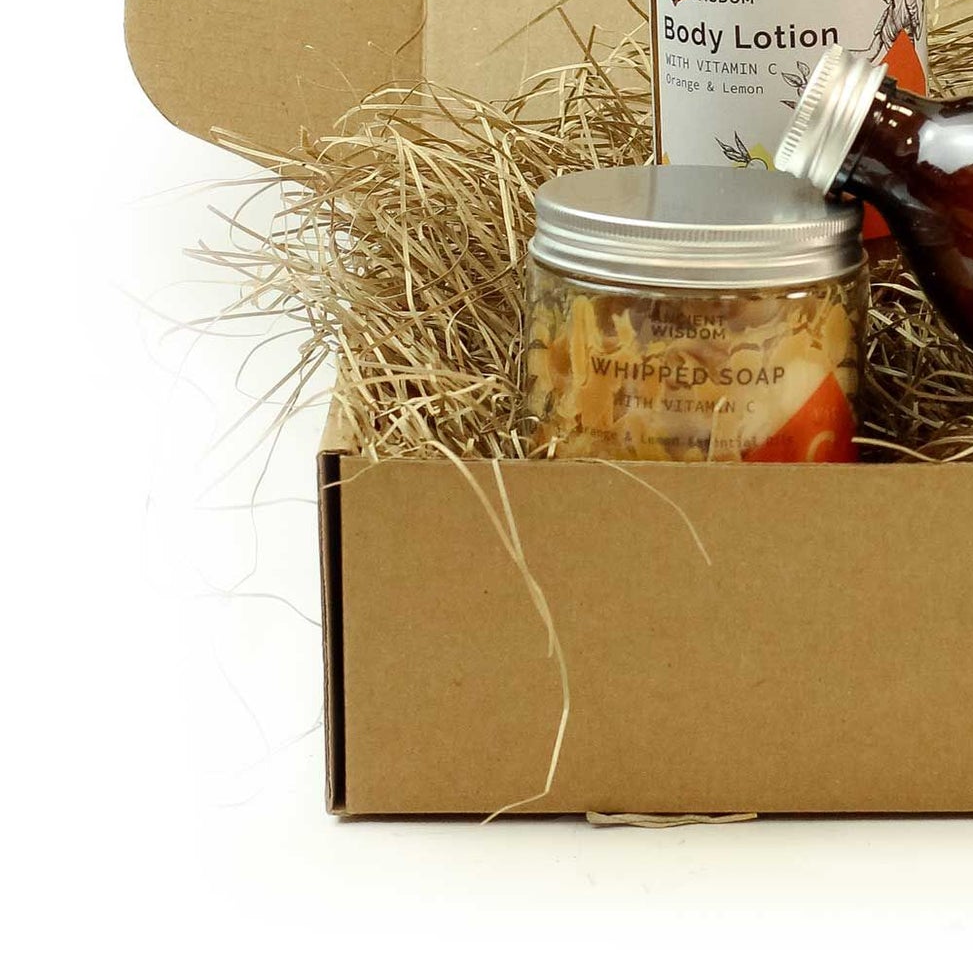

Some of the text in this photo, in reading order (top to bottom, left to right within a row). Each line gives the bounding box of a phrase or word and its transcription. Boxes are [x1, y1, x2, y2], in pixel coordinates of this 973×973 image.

[664, 16, 838, 54] Body Lotion
[665, 53, 777, 75] WITH VITAMIN C
[665, 73, 764, 94] Orange & Lemon
[651, 325, 726, 340] WISDOM
[591, 356, 786, 385] WHIPPED SOAP
[746, 401, 756, 414] C
